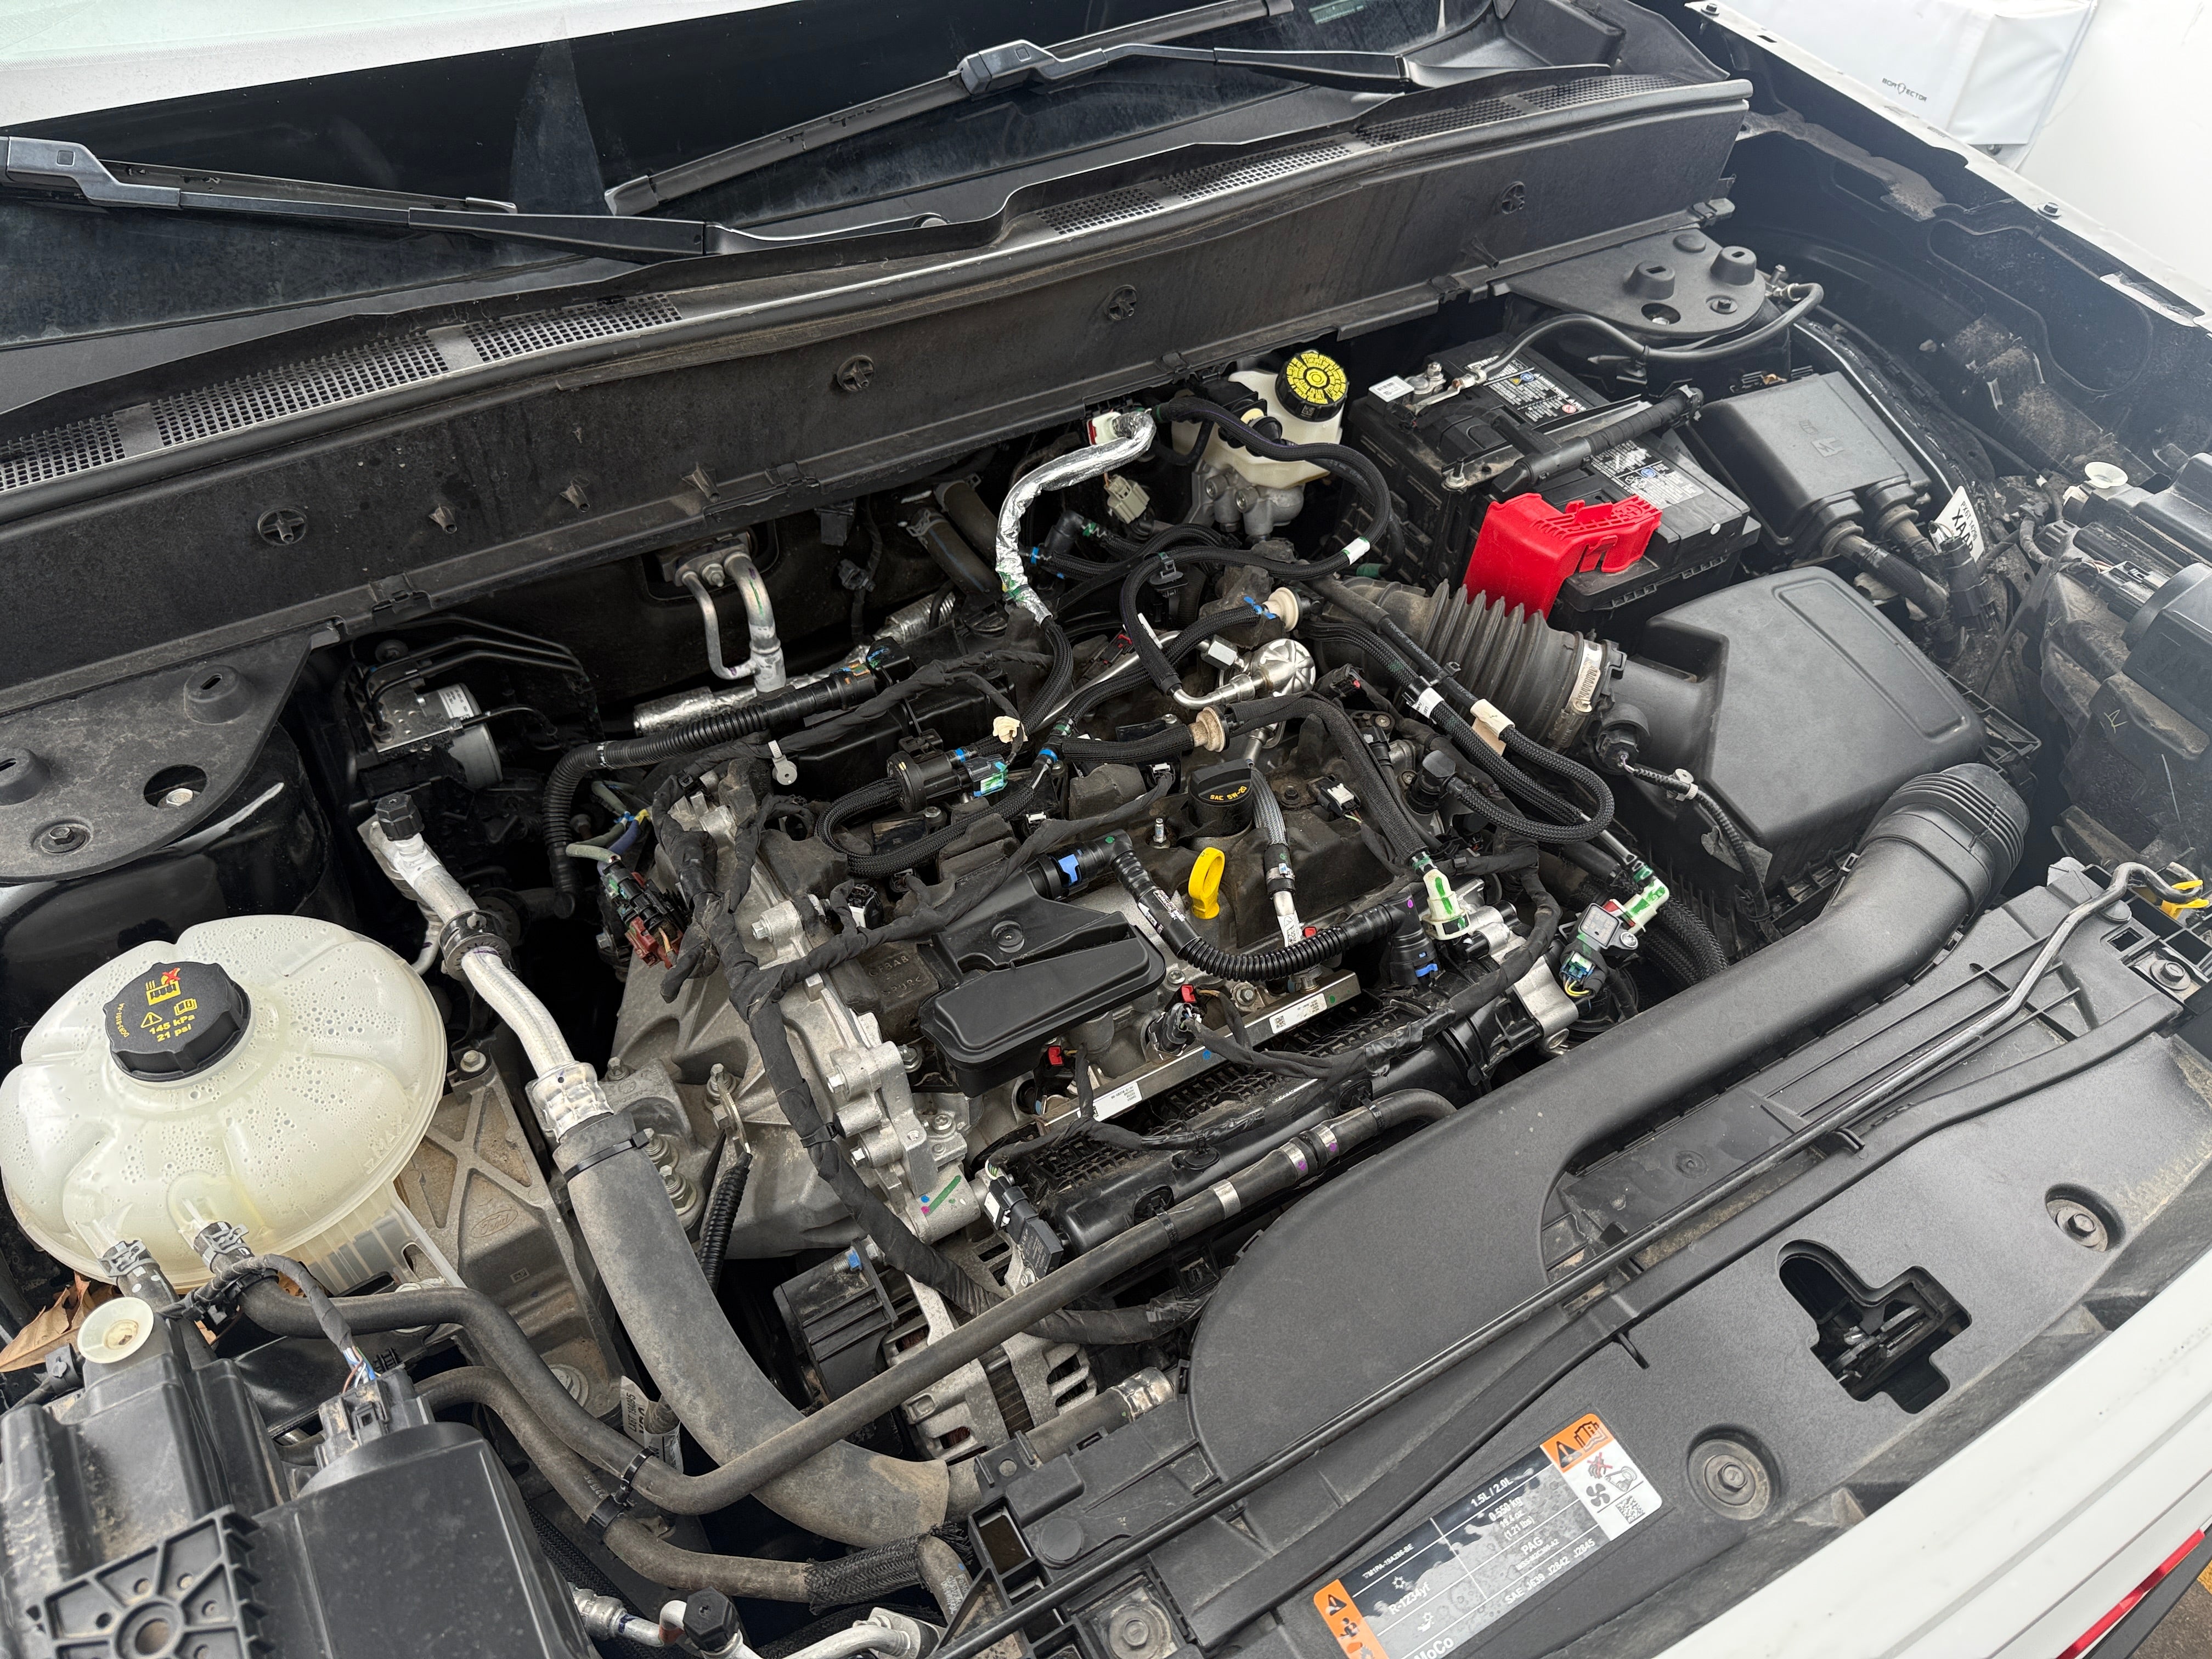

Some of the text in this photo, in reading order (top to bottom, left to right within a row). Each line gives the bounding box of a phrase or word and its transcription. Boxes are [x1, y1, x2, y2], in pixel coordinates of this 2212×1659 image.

[1209, 785, 1248, 802] SAE 5W-20
[149, 1014, 195, 1035] 145 kPa
[156, 1023, 192, 1042] 21 psi
[479, 1209, 511, 1235] Ford
[1470, 1489, 1491, 1508] 1.5L
[1493, 1476, 1514, 1493] 2.0L
[1488, 1496, 1524, 1522] 0.550 kg
[1519, 1515, 1536, 1533] lbs)
[1521, 1536, 1544, 1555] PAG
[1505, 1538, 1596, 1605] SAE J639 J2842 J2845
[1389, 1582, 1431, 1615] R-1234yf
